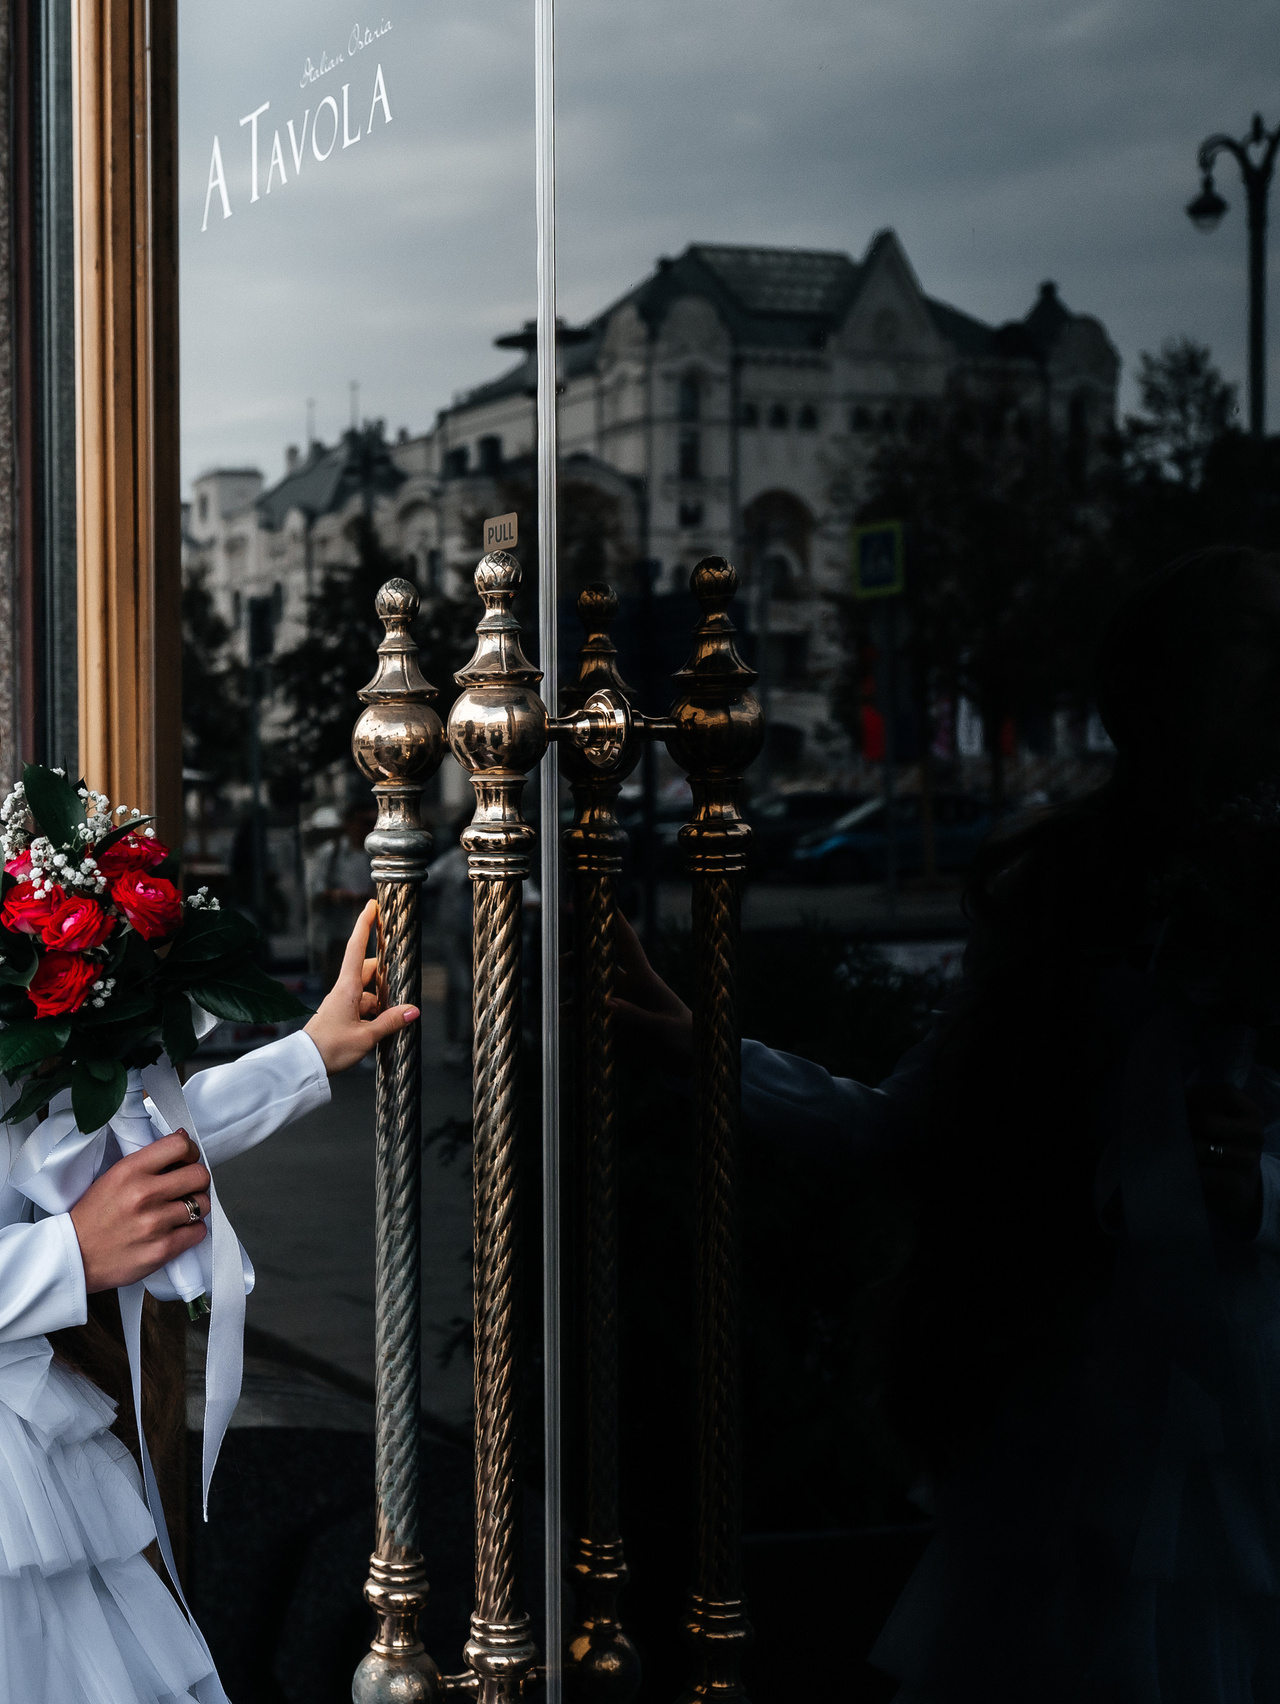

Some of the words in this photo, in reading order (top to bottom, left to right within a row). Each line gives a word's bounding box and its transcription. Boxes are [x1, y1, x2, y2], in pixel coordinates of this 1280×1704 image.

[299, 51, 345, 89] Italian
[347, 18, 394, 57] Osteria
[201, 134, 233, 233] A
[487, 522, 515, 545] PULL
